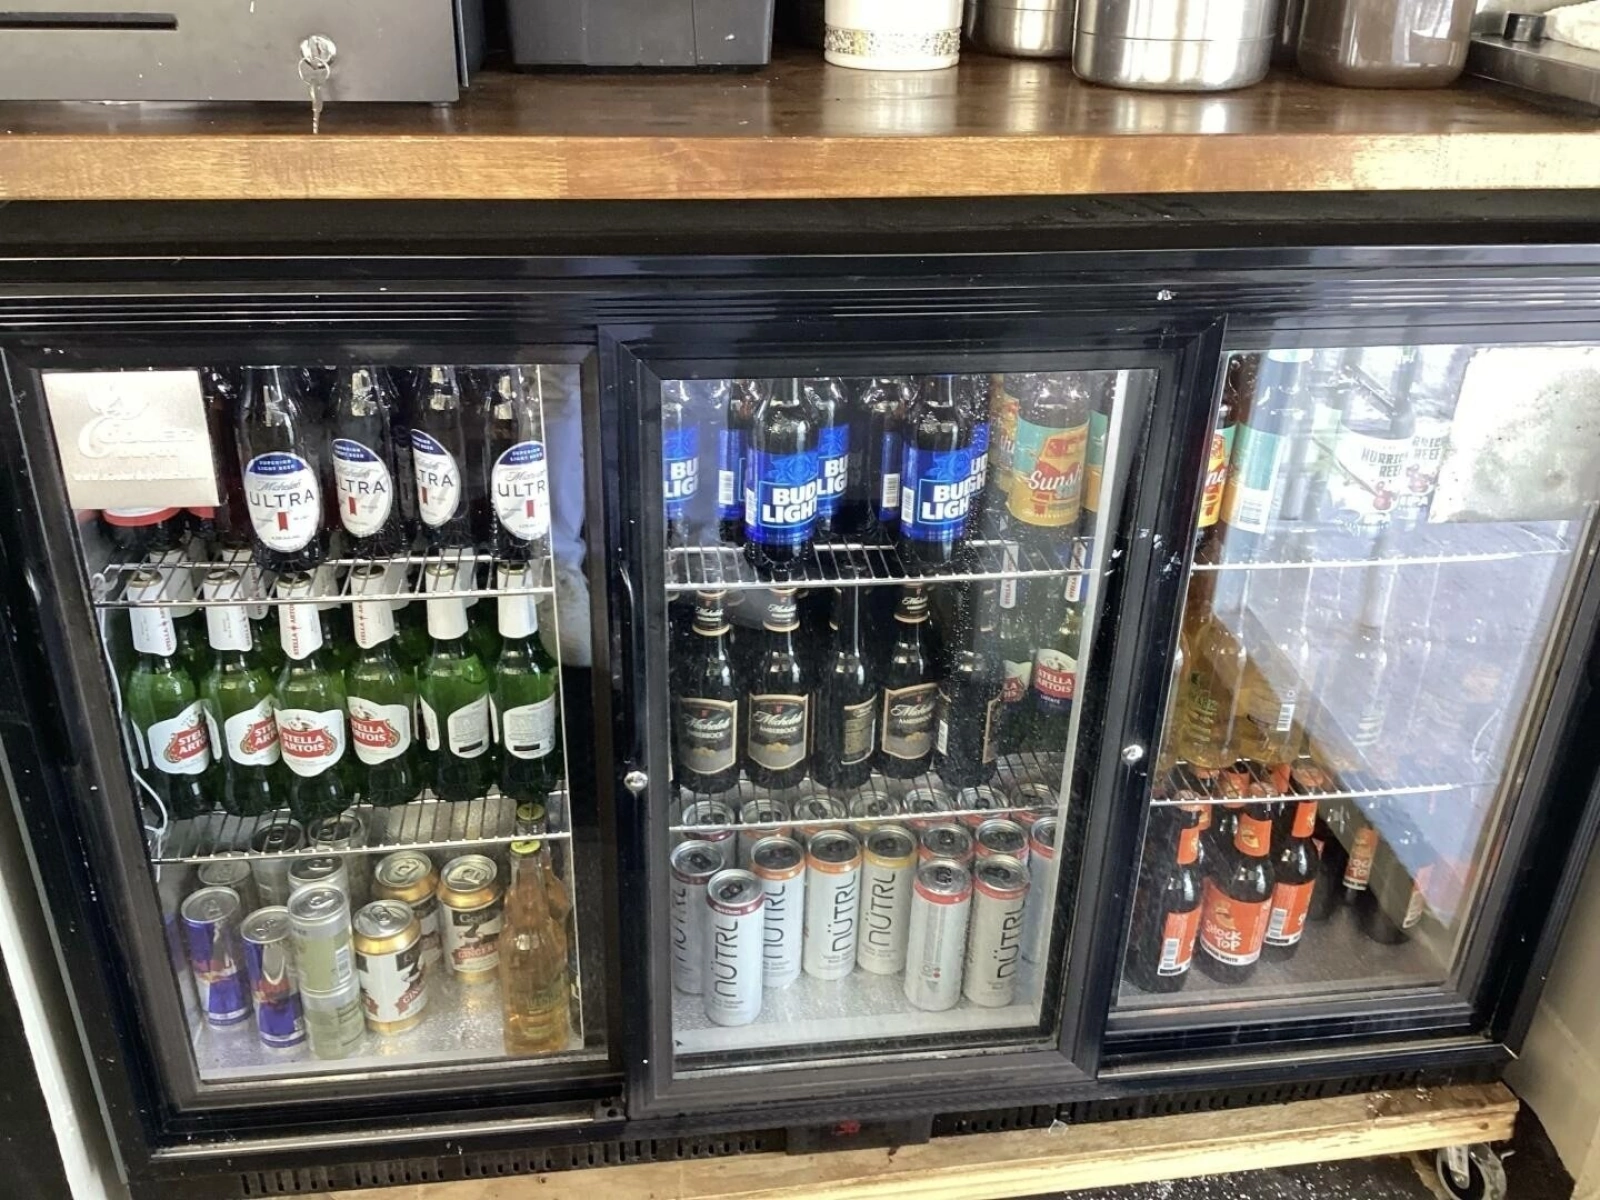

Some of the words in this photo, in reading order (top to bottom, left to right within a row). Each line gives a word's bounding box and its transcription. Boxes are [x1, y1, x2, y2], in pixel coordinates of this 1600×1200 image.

[671, 458, 699, 480] BU
[825, 454, 849, 478] BU
[498, 480, 547, 498] ULTR
[663, 475, 699, 498] LIG
[773, 481, 817, 506] BUD
[817, 473, 848, 495] LIG
[250, 488, 316, 508] ULTRA
[922, 495, 970, 520] LIGH
[763, 498, 817, 523] LIGH
[283, 732, 324, 743] STELLA
[284, 741, 326, 752] ARTOIS
[1215, 935, 1241, 952] TOP
